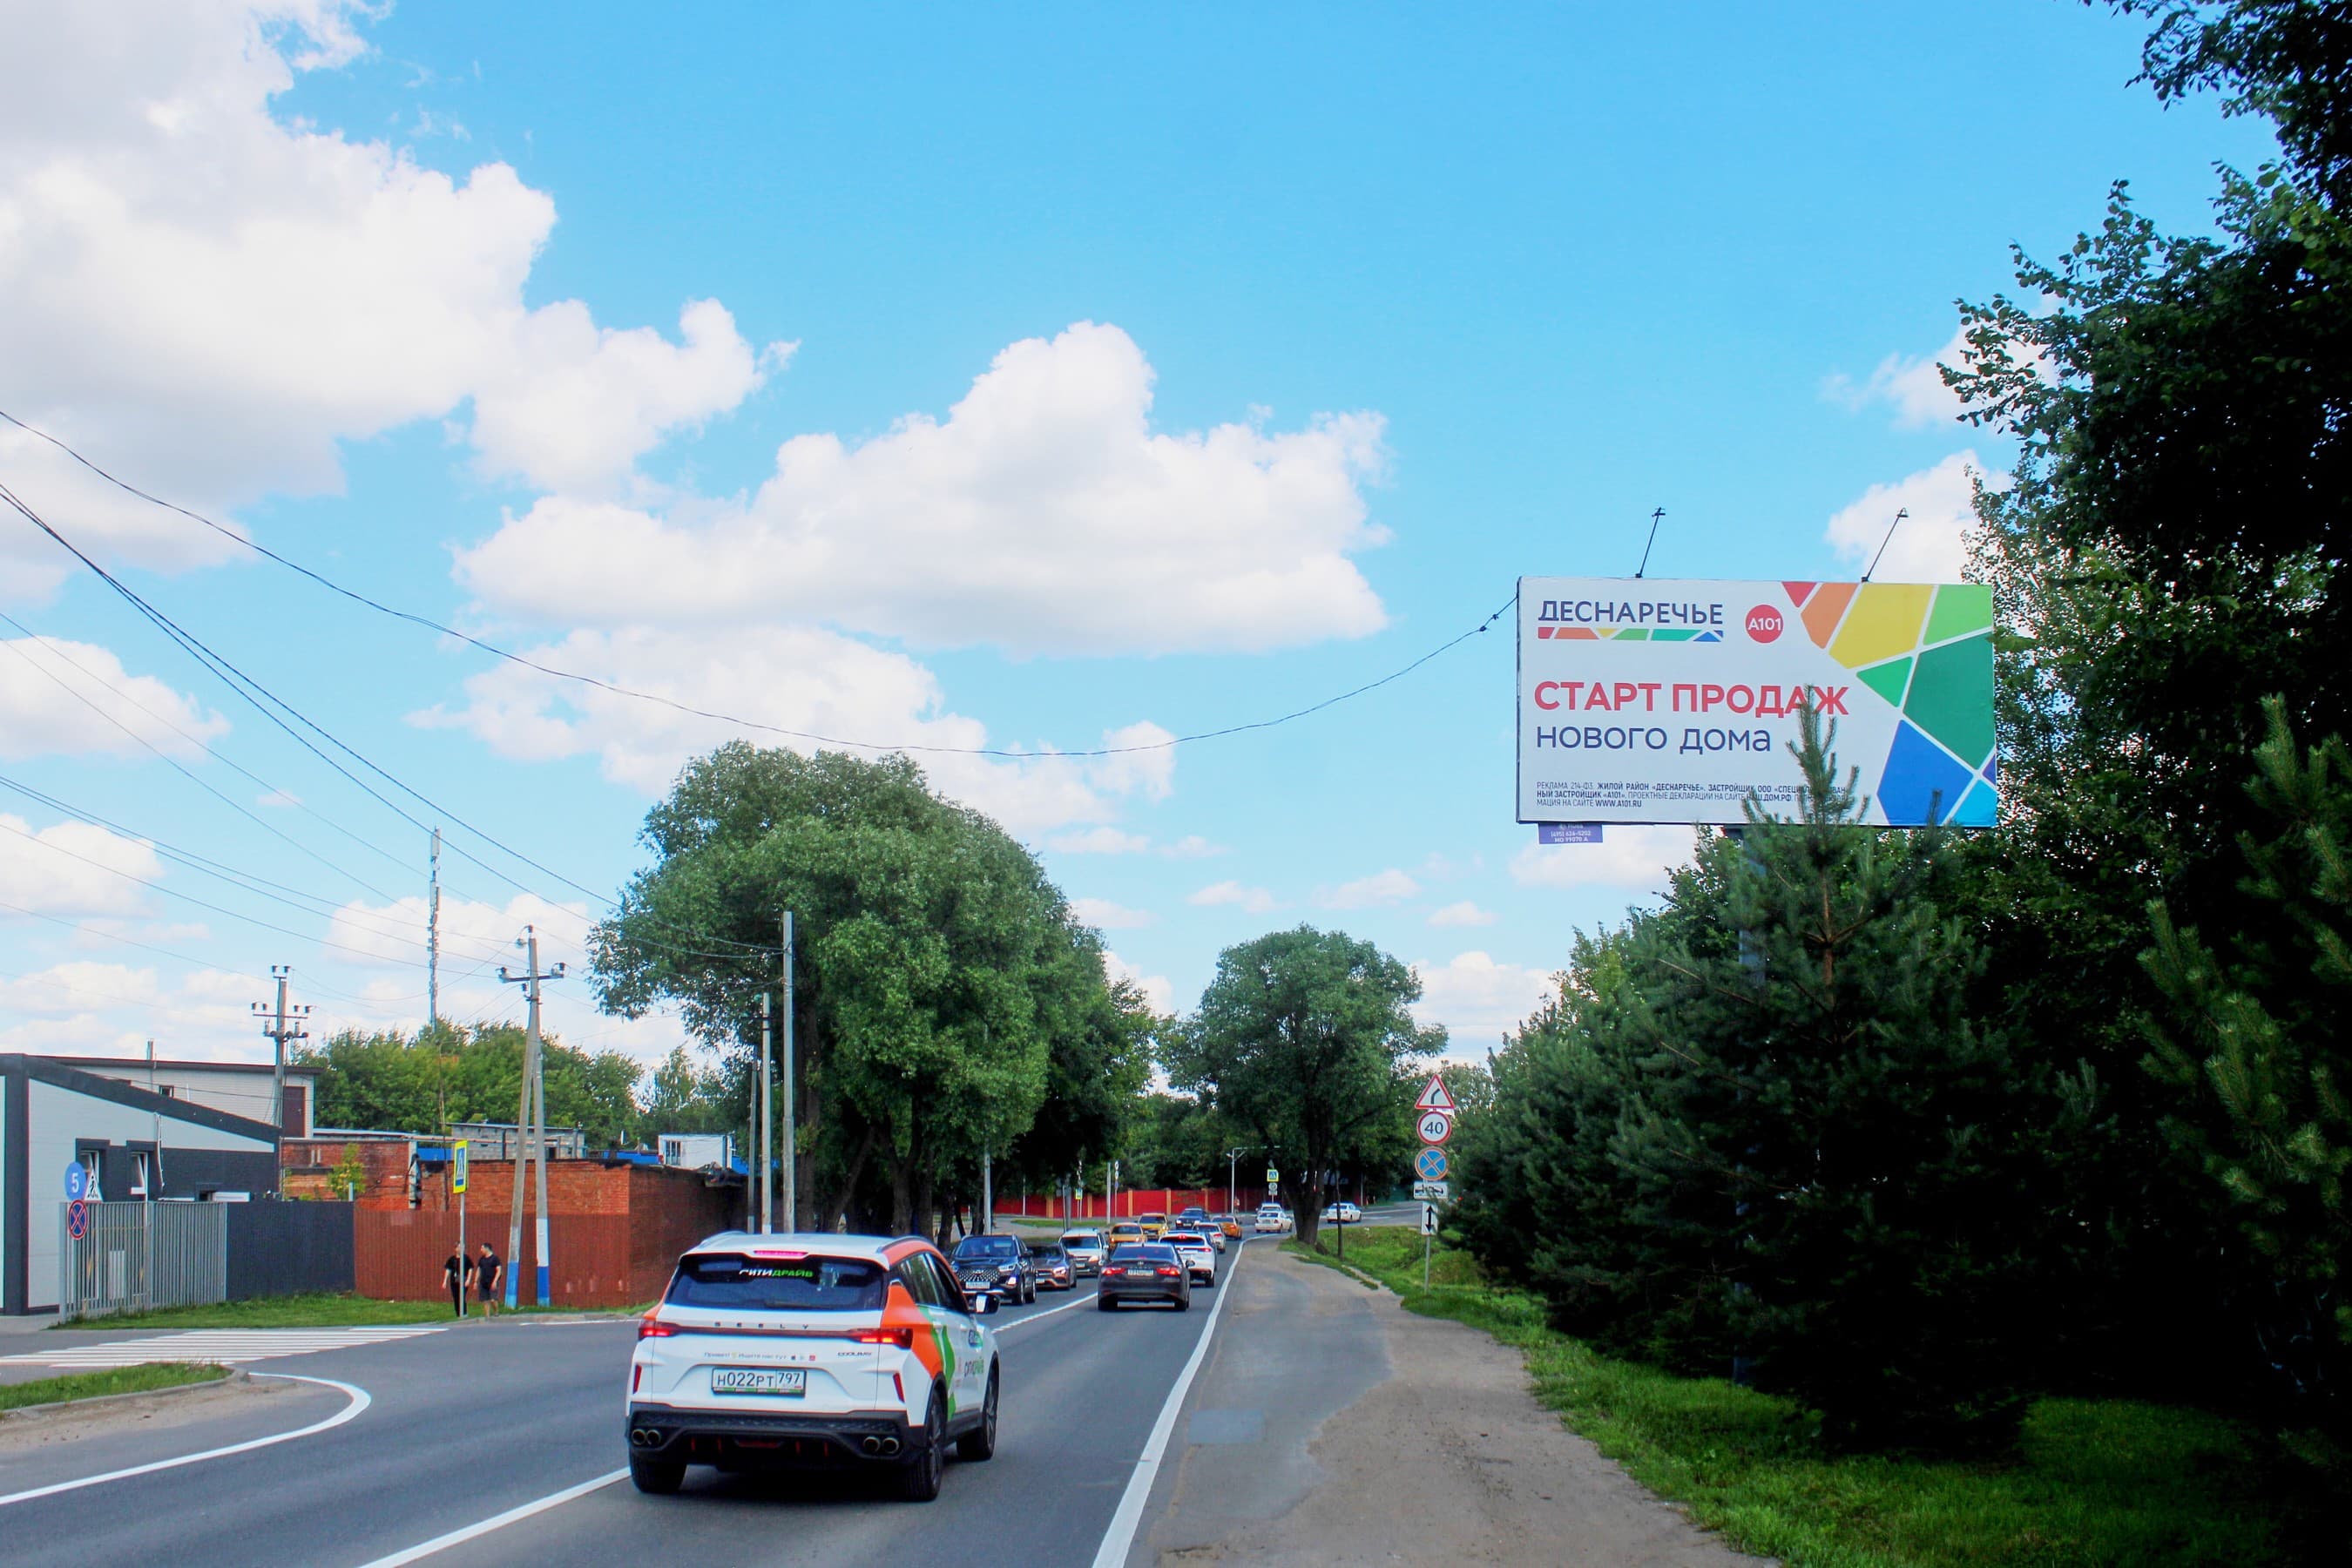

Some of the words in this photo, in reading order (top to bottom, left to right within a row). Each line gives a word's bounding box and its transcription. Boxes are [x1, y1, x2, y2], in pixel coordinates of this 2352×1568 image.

[1538, 600, 1723, 625] ДЕСНАРЕЧЬЕ
[1534, 680, 1662, 712] СТАРТ
[1672, 683, 1849, 719] ПРОДАЖ
[1598, 781, 1623, 790] ЖИЛОЙ
[1625, 781, 1649, 790] РАЙОН
[1555, 789, 1602, 799] ЗАСТРОЙЩИК
[1628, 791, 1668, 800] ПРОЕКТНЫЕ
[1669, 791, 1713, 801] ДЕКЛАРАЦИИ
[1595, 799, 1642, 808] WWW.A101.RU
[1424, 1121, 1443, 1134] 40
[71, 1172, 79, 1193] 5
[717, 1372, 774, 1387] Н022РТ
[778, 1372, 801, 1383] 797
